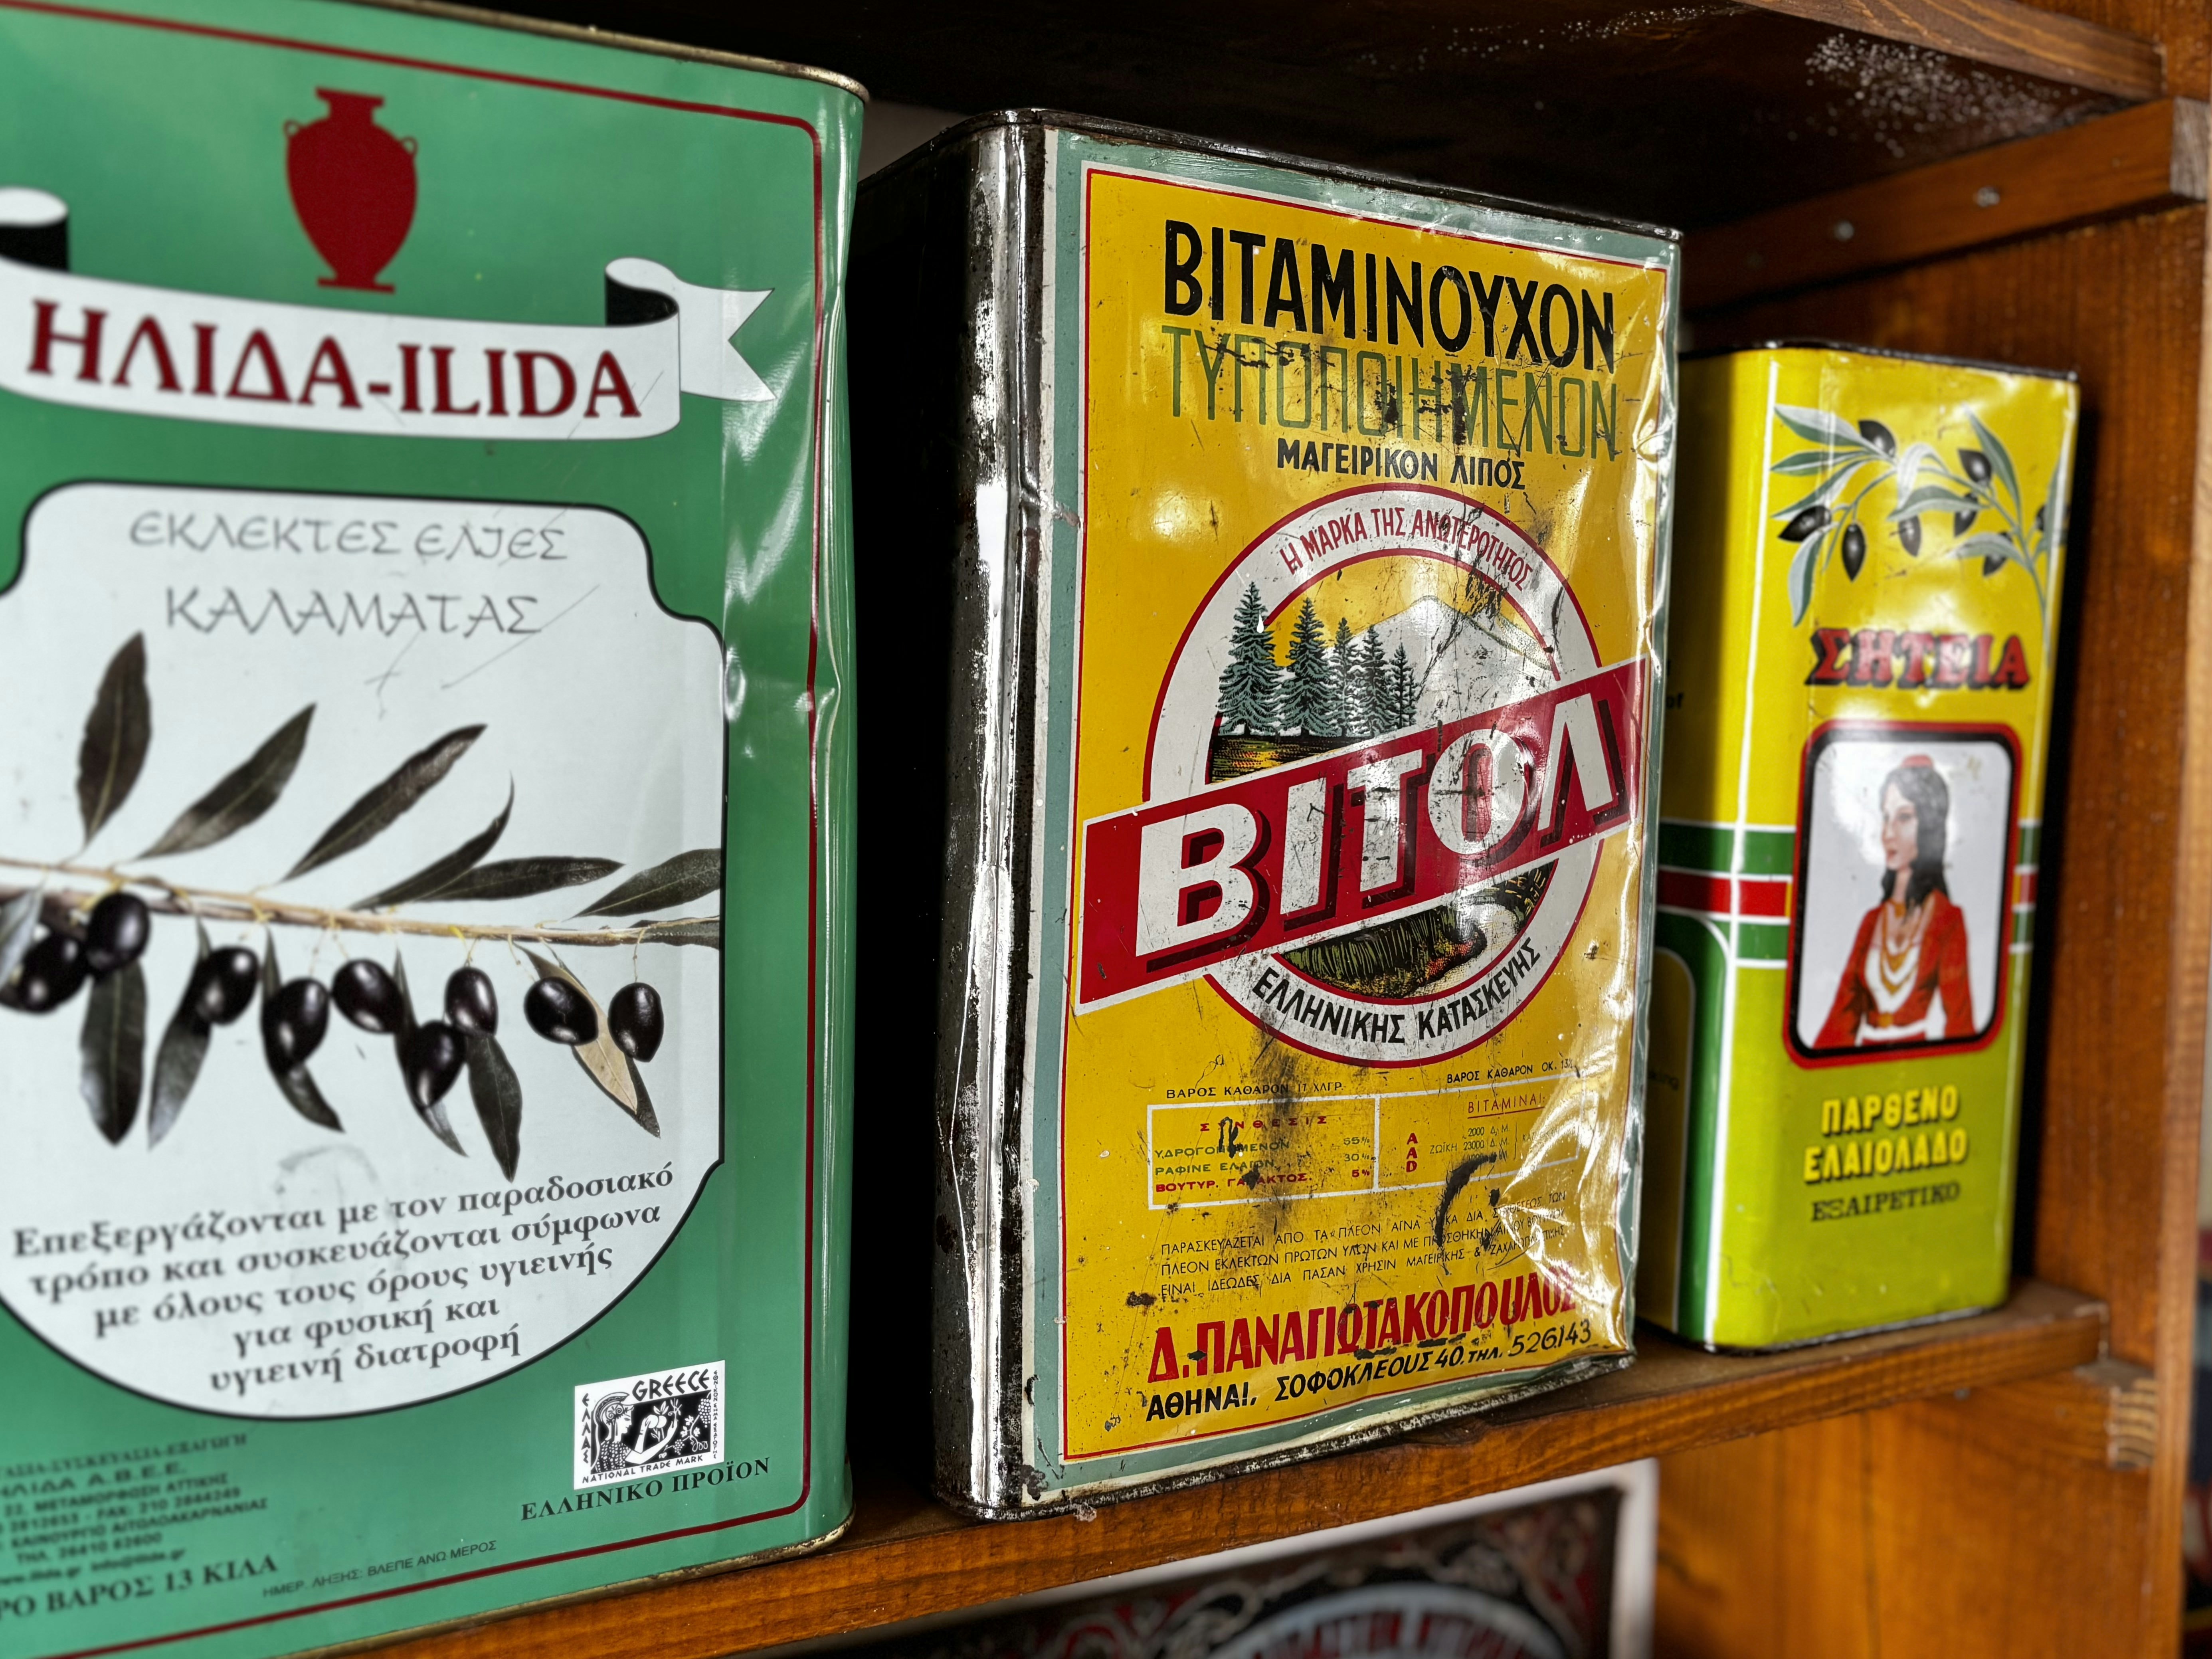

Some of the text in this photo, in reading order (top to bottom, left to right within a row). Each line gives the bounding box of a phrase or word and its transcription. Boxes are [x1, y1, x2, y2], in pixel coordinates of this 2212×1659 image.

[1164, 220, 1615, 374] ΒΙΤΑΜΙΝΟΥΧΟΝ
[28, 300, 642, 418] ΗΛΙΔΑ-ILIDA
[1161, 325, 1617, 461] ΤΥΠΟΠΟΙΗΜΕΝΟΝ
[1277, 438, 1525, 490] ΜΑΓΕΙΡΙΚΟΝ ΛΙΠΟΣ
[130, 511, 400, 554] ΕΚΛΕΚΤΕΣ
[1280, 507, 1533, 592] Η ΜΑΡΚΑ ΤΗΣ ΑΝΩΤΕΡΟΤΗΤΟΣ
[166, 587, 542, 637] ΚΑΛΑΜΑΤΑΣ
[1804, 628, 2030, 690] ΣΗΤΕΙΑ
[1136, 693, 1629, 972] ΒΙΤΟΛ
[1252, 937, 1541, 1044] ΕΛΛΗΝΙΚΗΣ ΚΑΤΑΣΚΕΥΗΣ
[1167, 1087, 1216, 1099] ΒΑΡΟΣ
[1225, 1085, 1288, 1096] ΚΑΘΑΡΟΝ
[1447, 1071, 1480, 1084] ΒΑΡΟΣ
[1487, 1064, 1533, 1079] ΚΑΘΑΡΟΝ
[1821, 1084, 1961, 1137] ΠΑΡΘΕΝΟ
[1155, 1141, 1290, 1159] ΥΔΡΟΓΟΝΜΕΝΟΝ
[1155, 1164, 1211, 1175] ΡΑΦΙΝΕ
[1803, 1127, 1969, 1185] ΕΛΑΙΟΛΑΔΟ
[1228, 1173, 1312, 1187] ΓΑΑΚΤΟΣ.
[1811, 1181, 1961, 1222] ΕΞΑΙΡΕΤΙΚΟ
[13, 1161, 673, 1258] Επεξεργάζονται με τον παραδοσιακό
[1161, 1235, 1264, 1255] ΠΑΡΑΣΚΕΥΑΖΕΤΑΙ
[1275, 1231, 1304, 1245] ΑΠΟ
[1314, 1230, 1328, 1240] ΤΑ
[1339, 1223, 1381, 1238] ΠΛΕΟΝ
[1429, 1214, 1458, 1227] ΥΚΑ
[30, 1206, 661, 1304] τρόπο και συσκευάζονται σύμφωνα
[1161, 1261, 1209, 1275] ΠΛΕΟΝ
[1215, 1254, 1279, 1271] ΕΚΛΕΚΤΩΝ
[1284, 1247, 1337, 1263] ΠΡΩΤΩΝ
[1382, 1239, 1398, 1252] ΚΑΙ
[1403, 1236, 1419, 1249] ΜΕ
[1161, 1282, 1195, 1296] ΕΙΝΑΙ
[1209, 1275, 1260, 1292] ΙΔΕΩΔΕΣ
[1272, 1272, 1291, 1284] ΔΙΑ
[1303, 1265, 1345, 1281] ΠΑΣΑΝ
[1356, 1258, 1396, 1274] ΧΡΗΣΙΝ
[1407, 1248, 1465, 1267] ΜΑΓΕΙΡΙΚΗΣ
[1474, 1246, 1481, 1257] &
[95, 1242, 613, 1338] με όλους τους όρους υγιεινής
[233, 1297, 500, 1359] για φυσική και
[210, 1323, 521, 1397] υγιεινή διατροφή
[632, 1368, 710, 1402] GREECE
[1274, 1351, 1434, 1402] ΣΟΦΟΚΛΕΟΥΣ
[582, 1393, 592, 1463] ΕΛΛΑΣ
[521, 1457, 770, 1521] ΕΛΛΗΝΙΚΟ ΠΡΟΪΟΝ
[582, 1455, 703, 1483] NATIONAL TRADE MARK
[47, 1576, 154, 1612] ΒΑΡΟΣ
[165, 1568, 193, 1593] 13
[203, 1554, 279, 1585] ΚΙΛΑ
[368, 1558, 414, 1576] ΒΛΕΠΕ
[417, 1551, 447, 1566] ΑΝΩ
[450, 1540, 497, 1559] ΜΕΡΟΣ
